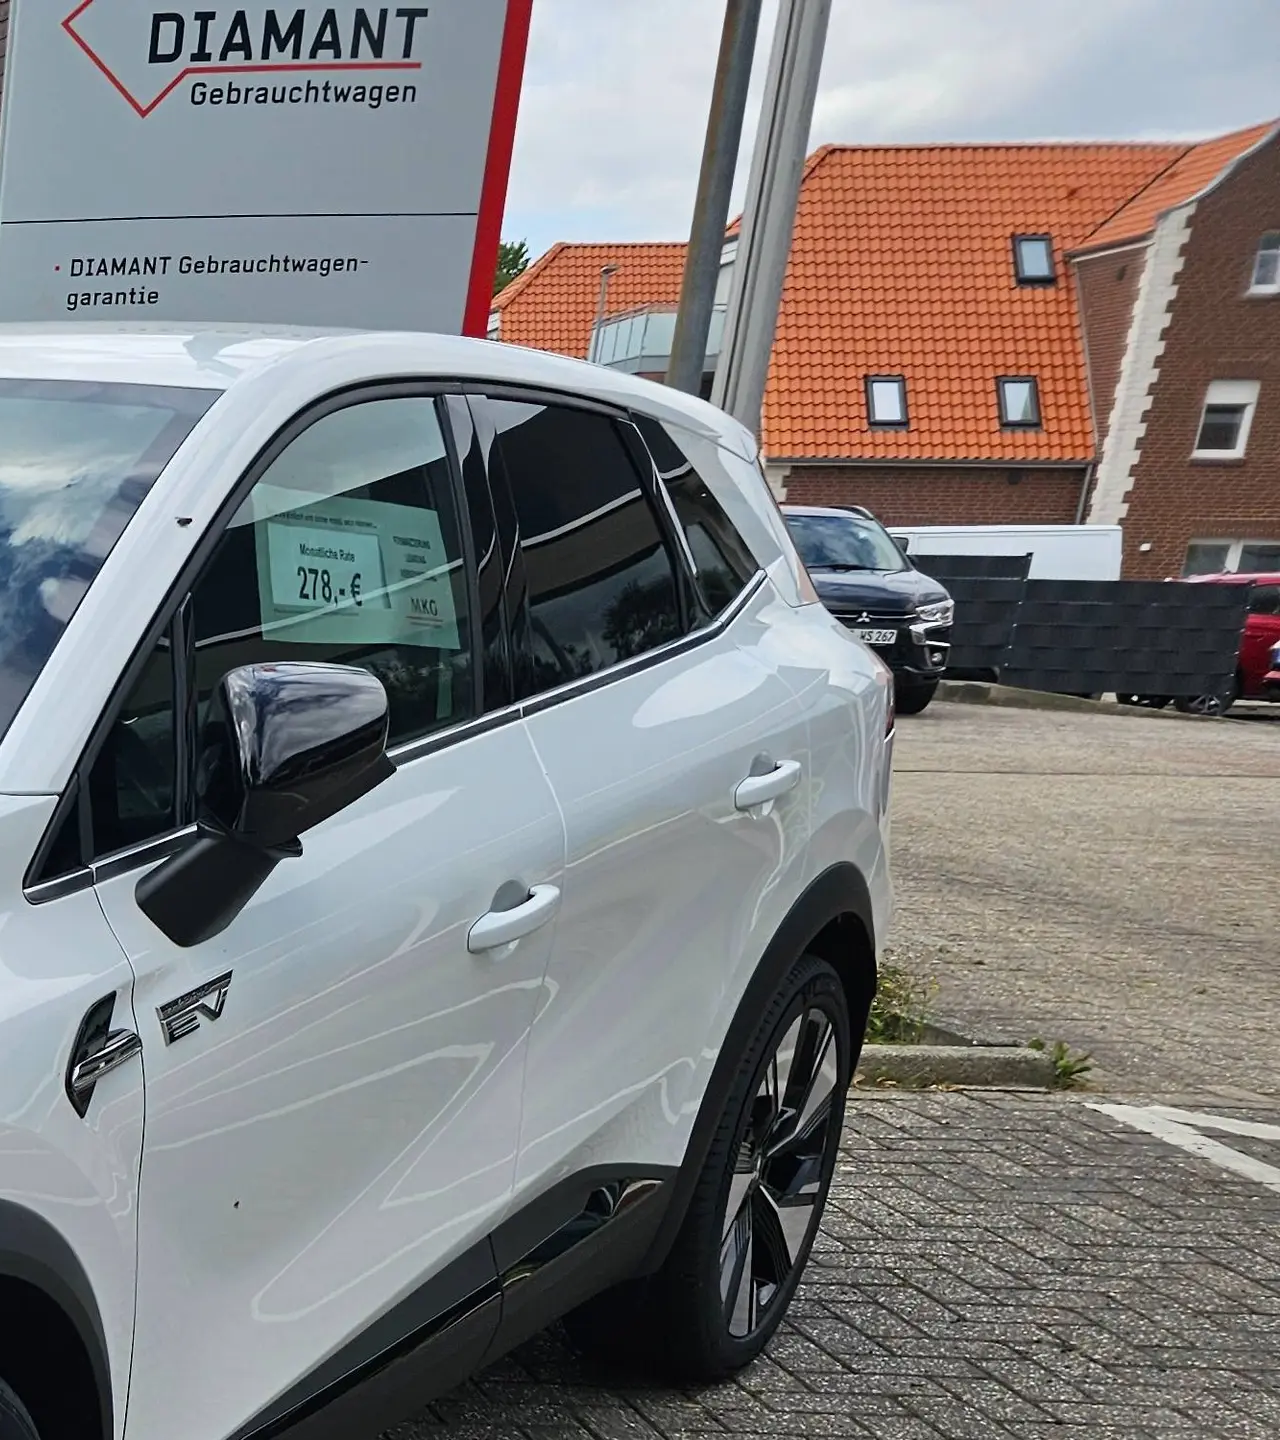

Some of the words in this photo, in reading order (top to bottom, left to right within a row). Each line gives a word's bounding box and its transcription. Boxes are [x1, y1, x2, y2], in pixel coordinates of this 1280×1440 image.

[148, 8, 428, 64] DIAMANT
[190, 81, 417, 109] Gebrauchtwagen
[70, 256, 172, 277] DIAMANT
[178, 256, 370, 279] Gebrauchtwagen-
[66, 286, 159, 311] garantie
[350, 573, 363, 607] €
